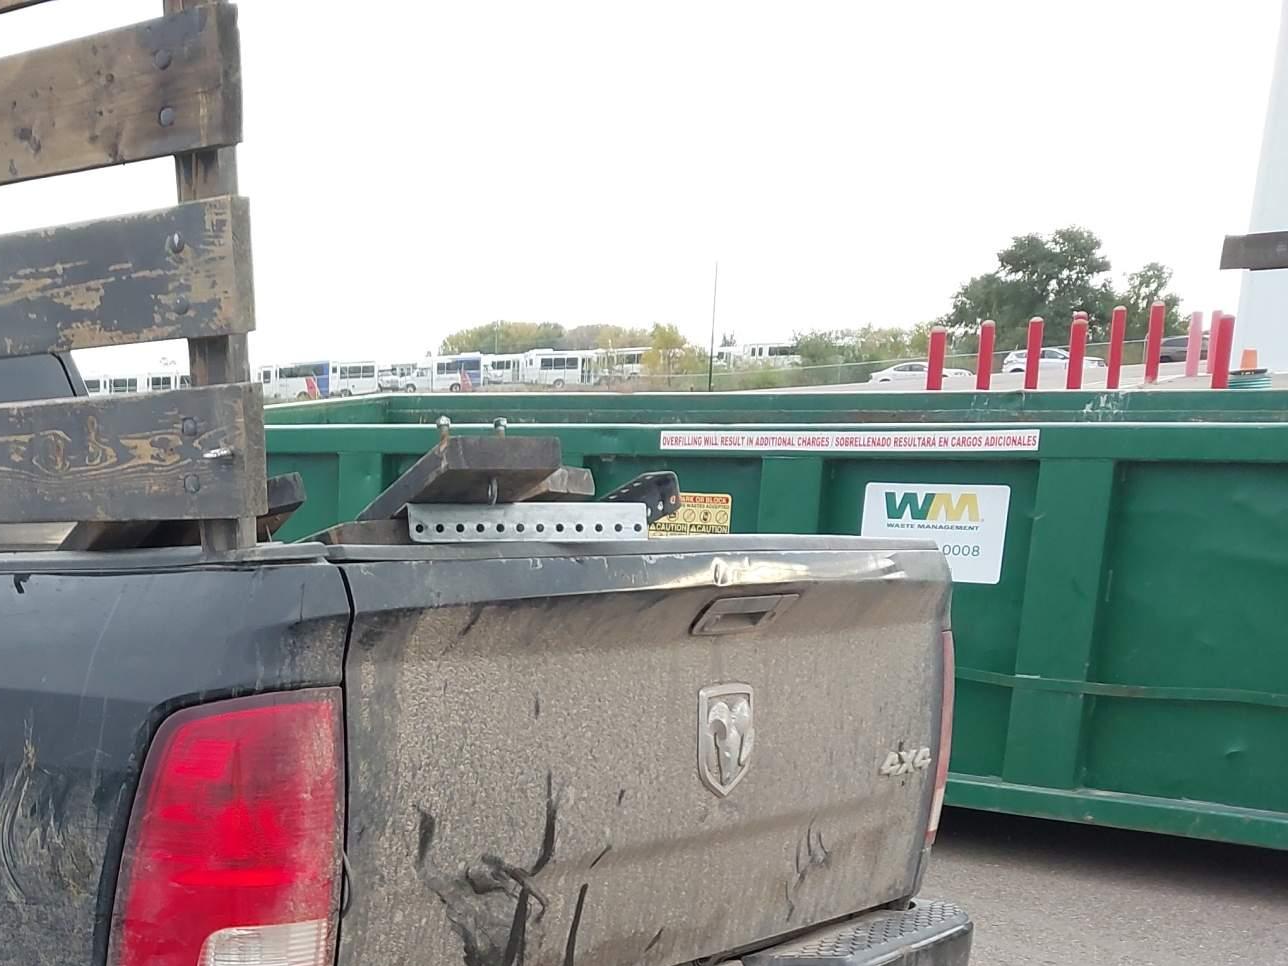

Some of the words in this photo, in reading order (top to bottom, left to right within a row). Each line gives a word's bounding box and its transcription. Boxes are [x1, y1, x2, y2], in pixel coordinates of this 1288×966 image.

[662, 436, 703, 446] OVERFILLING
[704, 436, 719, 446] WILL
[721, 436, 745, 447] RESULT
[746, 436, 754, 447] IN
[755, 436, 795, 447] ADDITIONAL
[797, 436, 829, 447] CHARGES
[835, 437, 892, 447] SOBRELLENADO
[893, 434, 936, 448] RESULTARÁ
[938, 436, 949, 448] EN
[950, 436, 983, 448] CARGOS
[984, 435, 1037, 447] ADICIONALES
[705, 496, 727, 504] BLOCK
[885, 491, 980, 522] WM
[656, 523, 687, 532] CAUTION
[696, 525, 728, 534] CAUTION
[917, 523, 980, 531] MANAGEMENT
